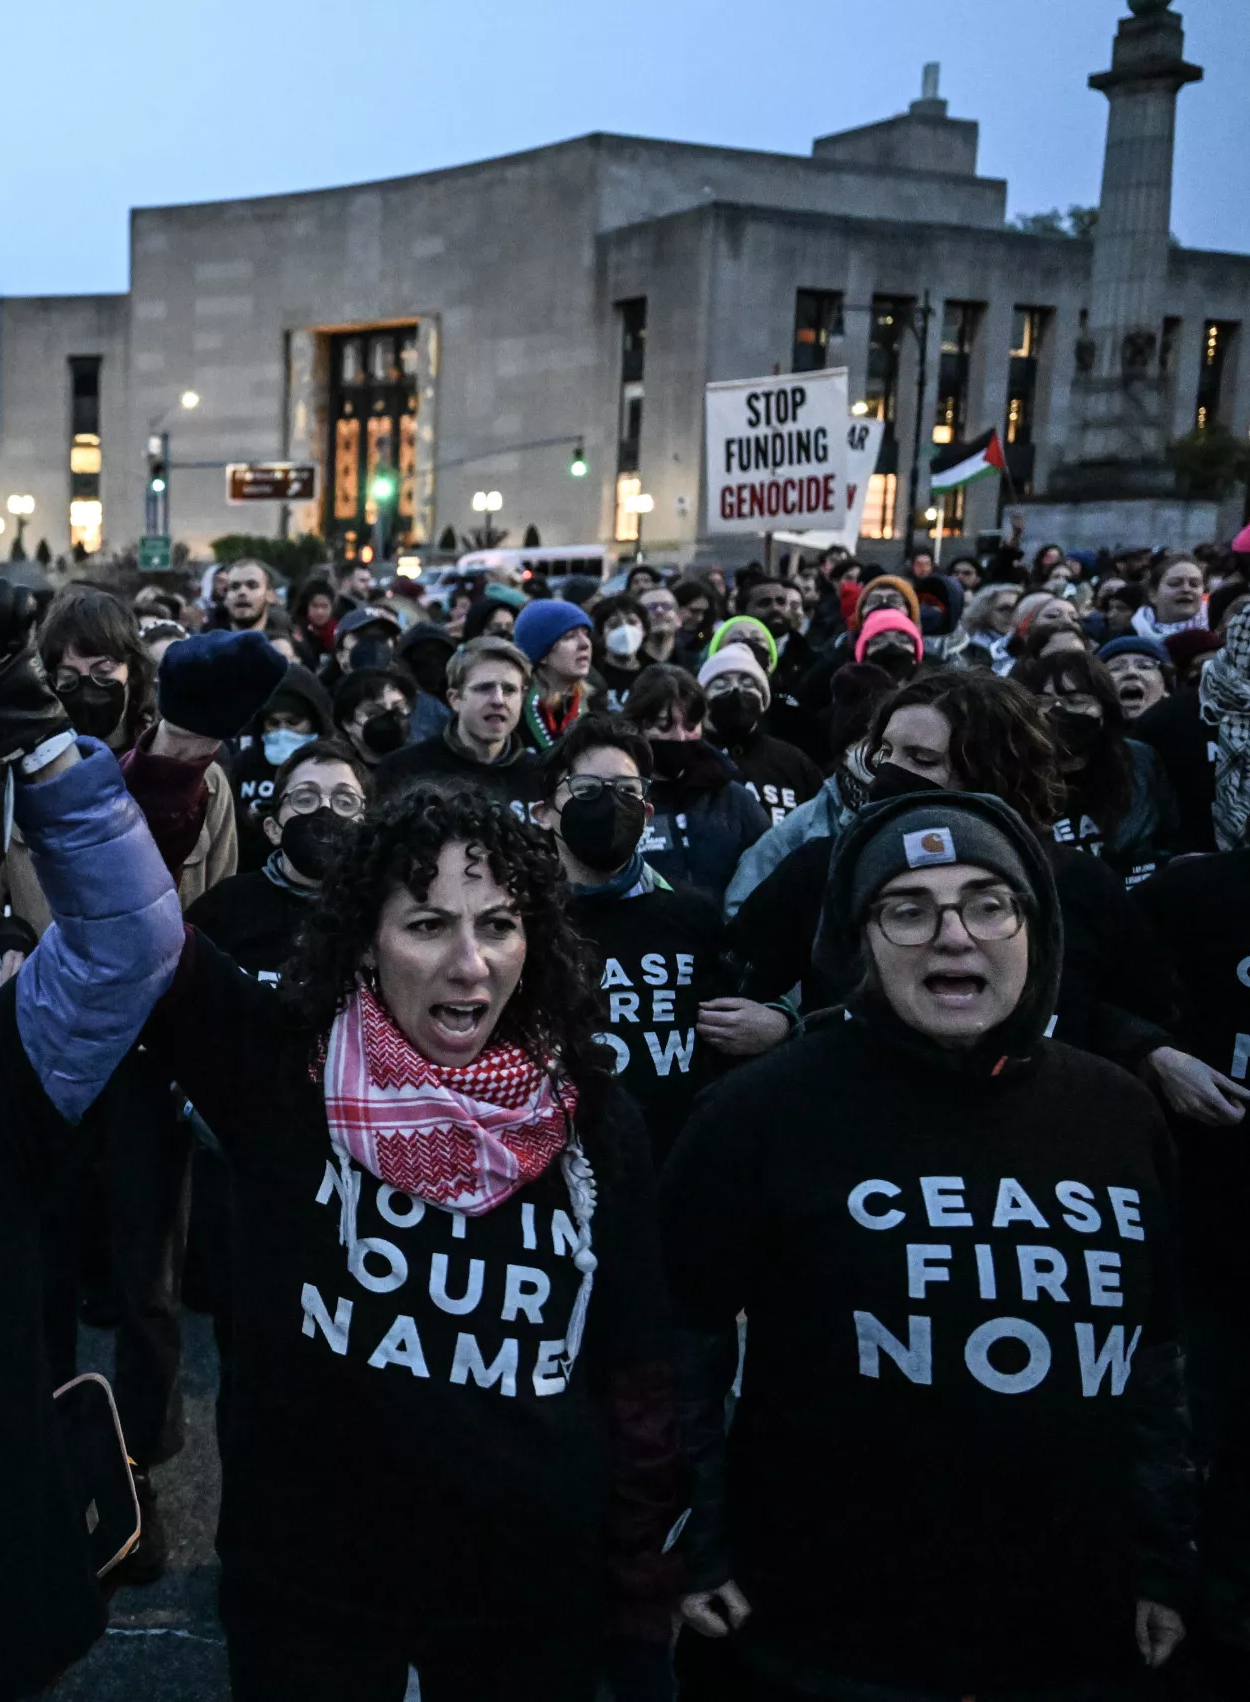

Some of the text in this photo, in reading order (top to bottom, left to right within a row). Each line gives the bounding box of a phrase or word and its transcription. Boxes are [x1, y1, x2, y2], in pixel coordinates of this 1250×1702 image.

[746, 386, 806, 428] STOP
[725, 426, 828, 473] FUNDING
[720, 474, 836, 520] GENOCIDE
[847, 1176, 1145, 1241] CEASE
[348, 1237, 551, 1324] OUR
[906, 1243, 1124, 1307] FIRE
[300, 1282, 570, 1397] NAME
[853, 1310, 1142, 1397] NOW
